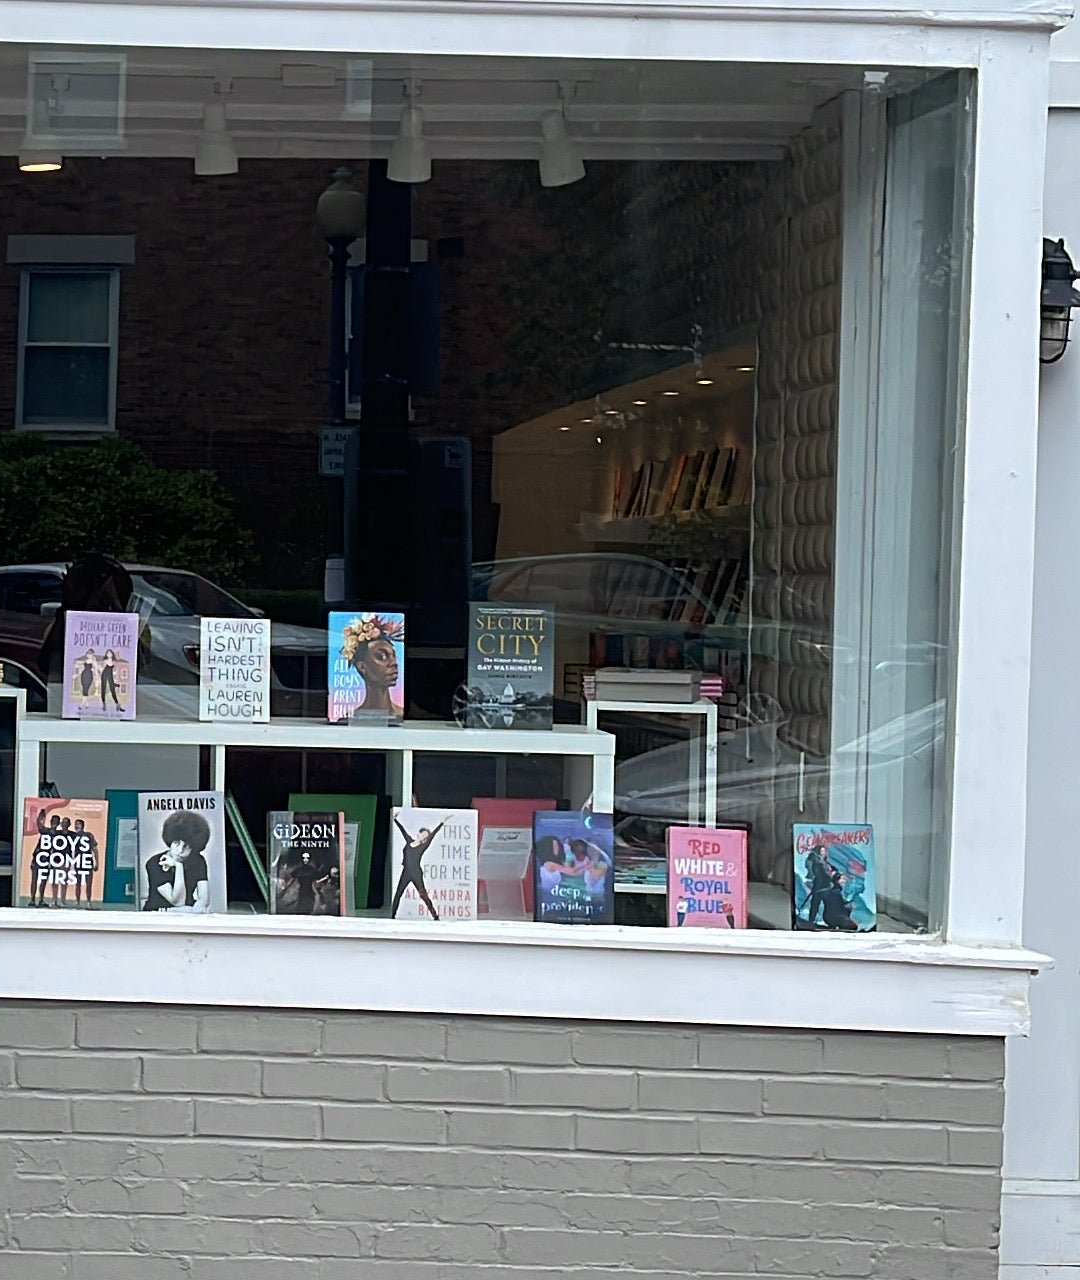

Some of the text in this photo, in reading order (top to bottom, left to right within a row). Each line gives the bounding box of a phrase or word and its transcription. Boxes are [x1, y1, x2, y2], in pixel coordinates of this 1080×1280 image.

[207, 621, 264, 634] LEAVING
[475, 615, 547, 631] SECRET
[74, 632, 131, 648] DOESN'T CARE
[208, 635, 257, 653] ISN'T
[476, 633, 545, 656] CITY
[207, 655, 264, 667] HARDEST
[208, 667, 262, 683] THING
[208, 689, 262, 703] LAUREN
[207, 704, 262, 717] HOUGH
[147, 798, 216, 810] ANGELA DAVIS
[443, 824, 471, 840] THIS
[40, 834, 90, 852] BOYS
[281, 840, 330, 848] THE NINTH
[688, 839, 721, 857] RED
[35, 851, 93, 869] COME
[441, 845, 471, 860] TIME
[423, 864, 471, 880] FOR ME
[674, 858, 738, 877] WHITE &
[37, 868, 90, 885] FIRST
[550, 884, 581, 900] deep
[681, 876, 732, 896] ROYAL
[404, 889, 472, 901] ALANDRA
[418, 903, 472, 918] BILINGS
[685, 897, 724, 914] BLUE
